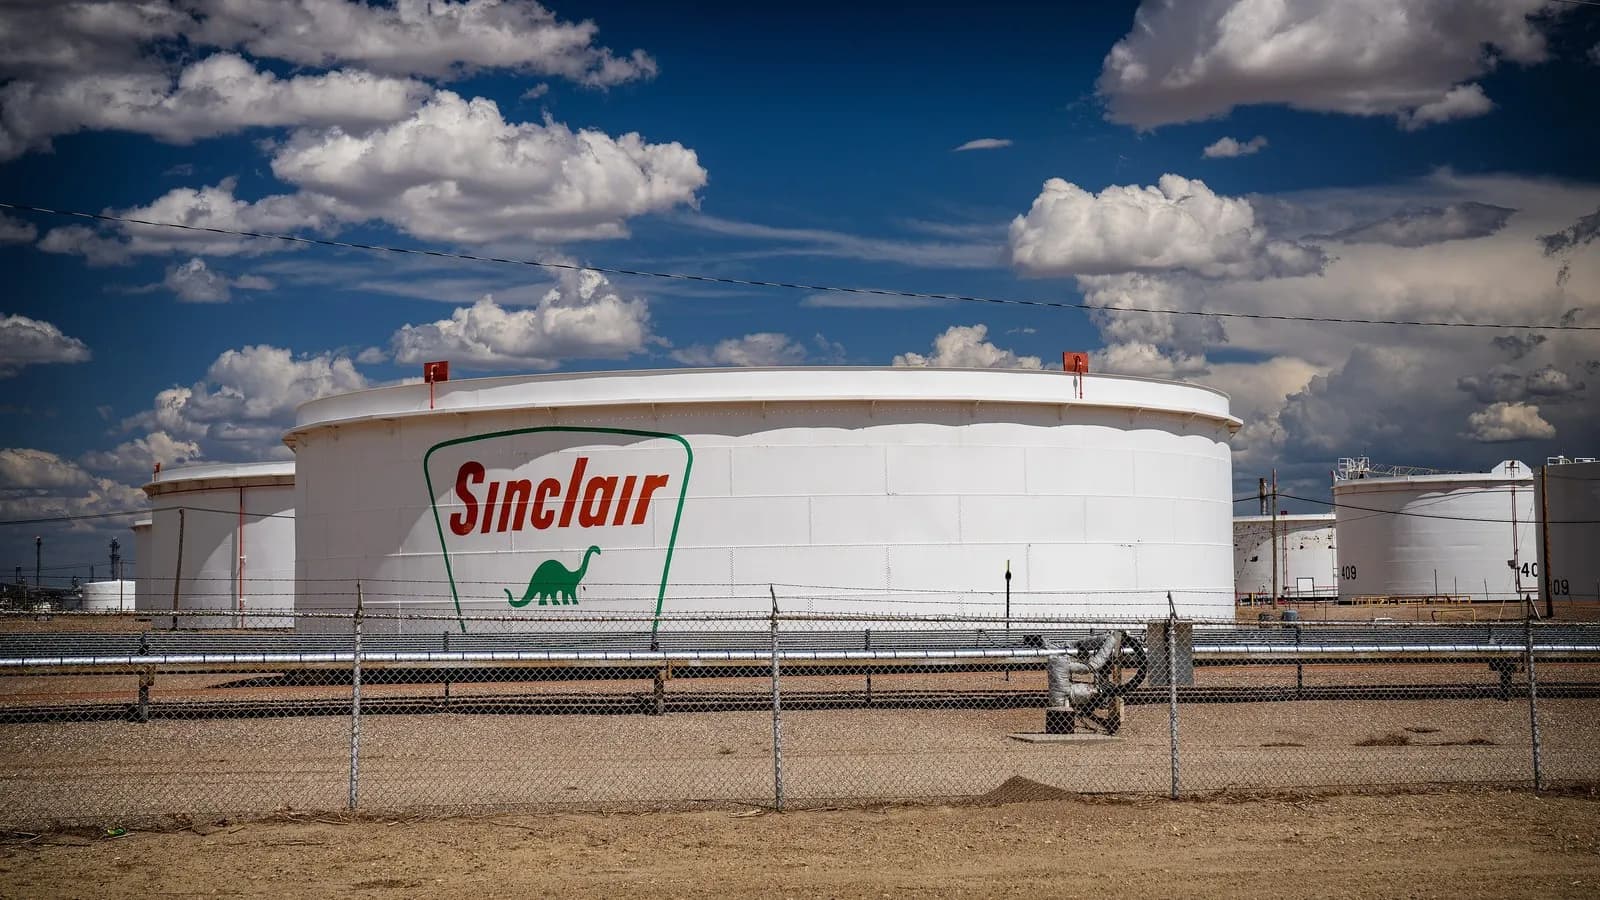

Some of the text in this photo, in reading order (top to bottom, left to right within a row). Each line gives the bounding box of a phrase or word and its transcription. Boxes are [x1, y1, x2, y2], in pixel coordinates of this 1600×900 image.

[450, 457, 669, 536] Sinclair
[1341, 565, 1357, 580] 409
[1551, 579, 1569, 596] 09
